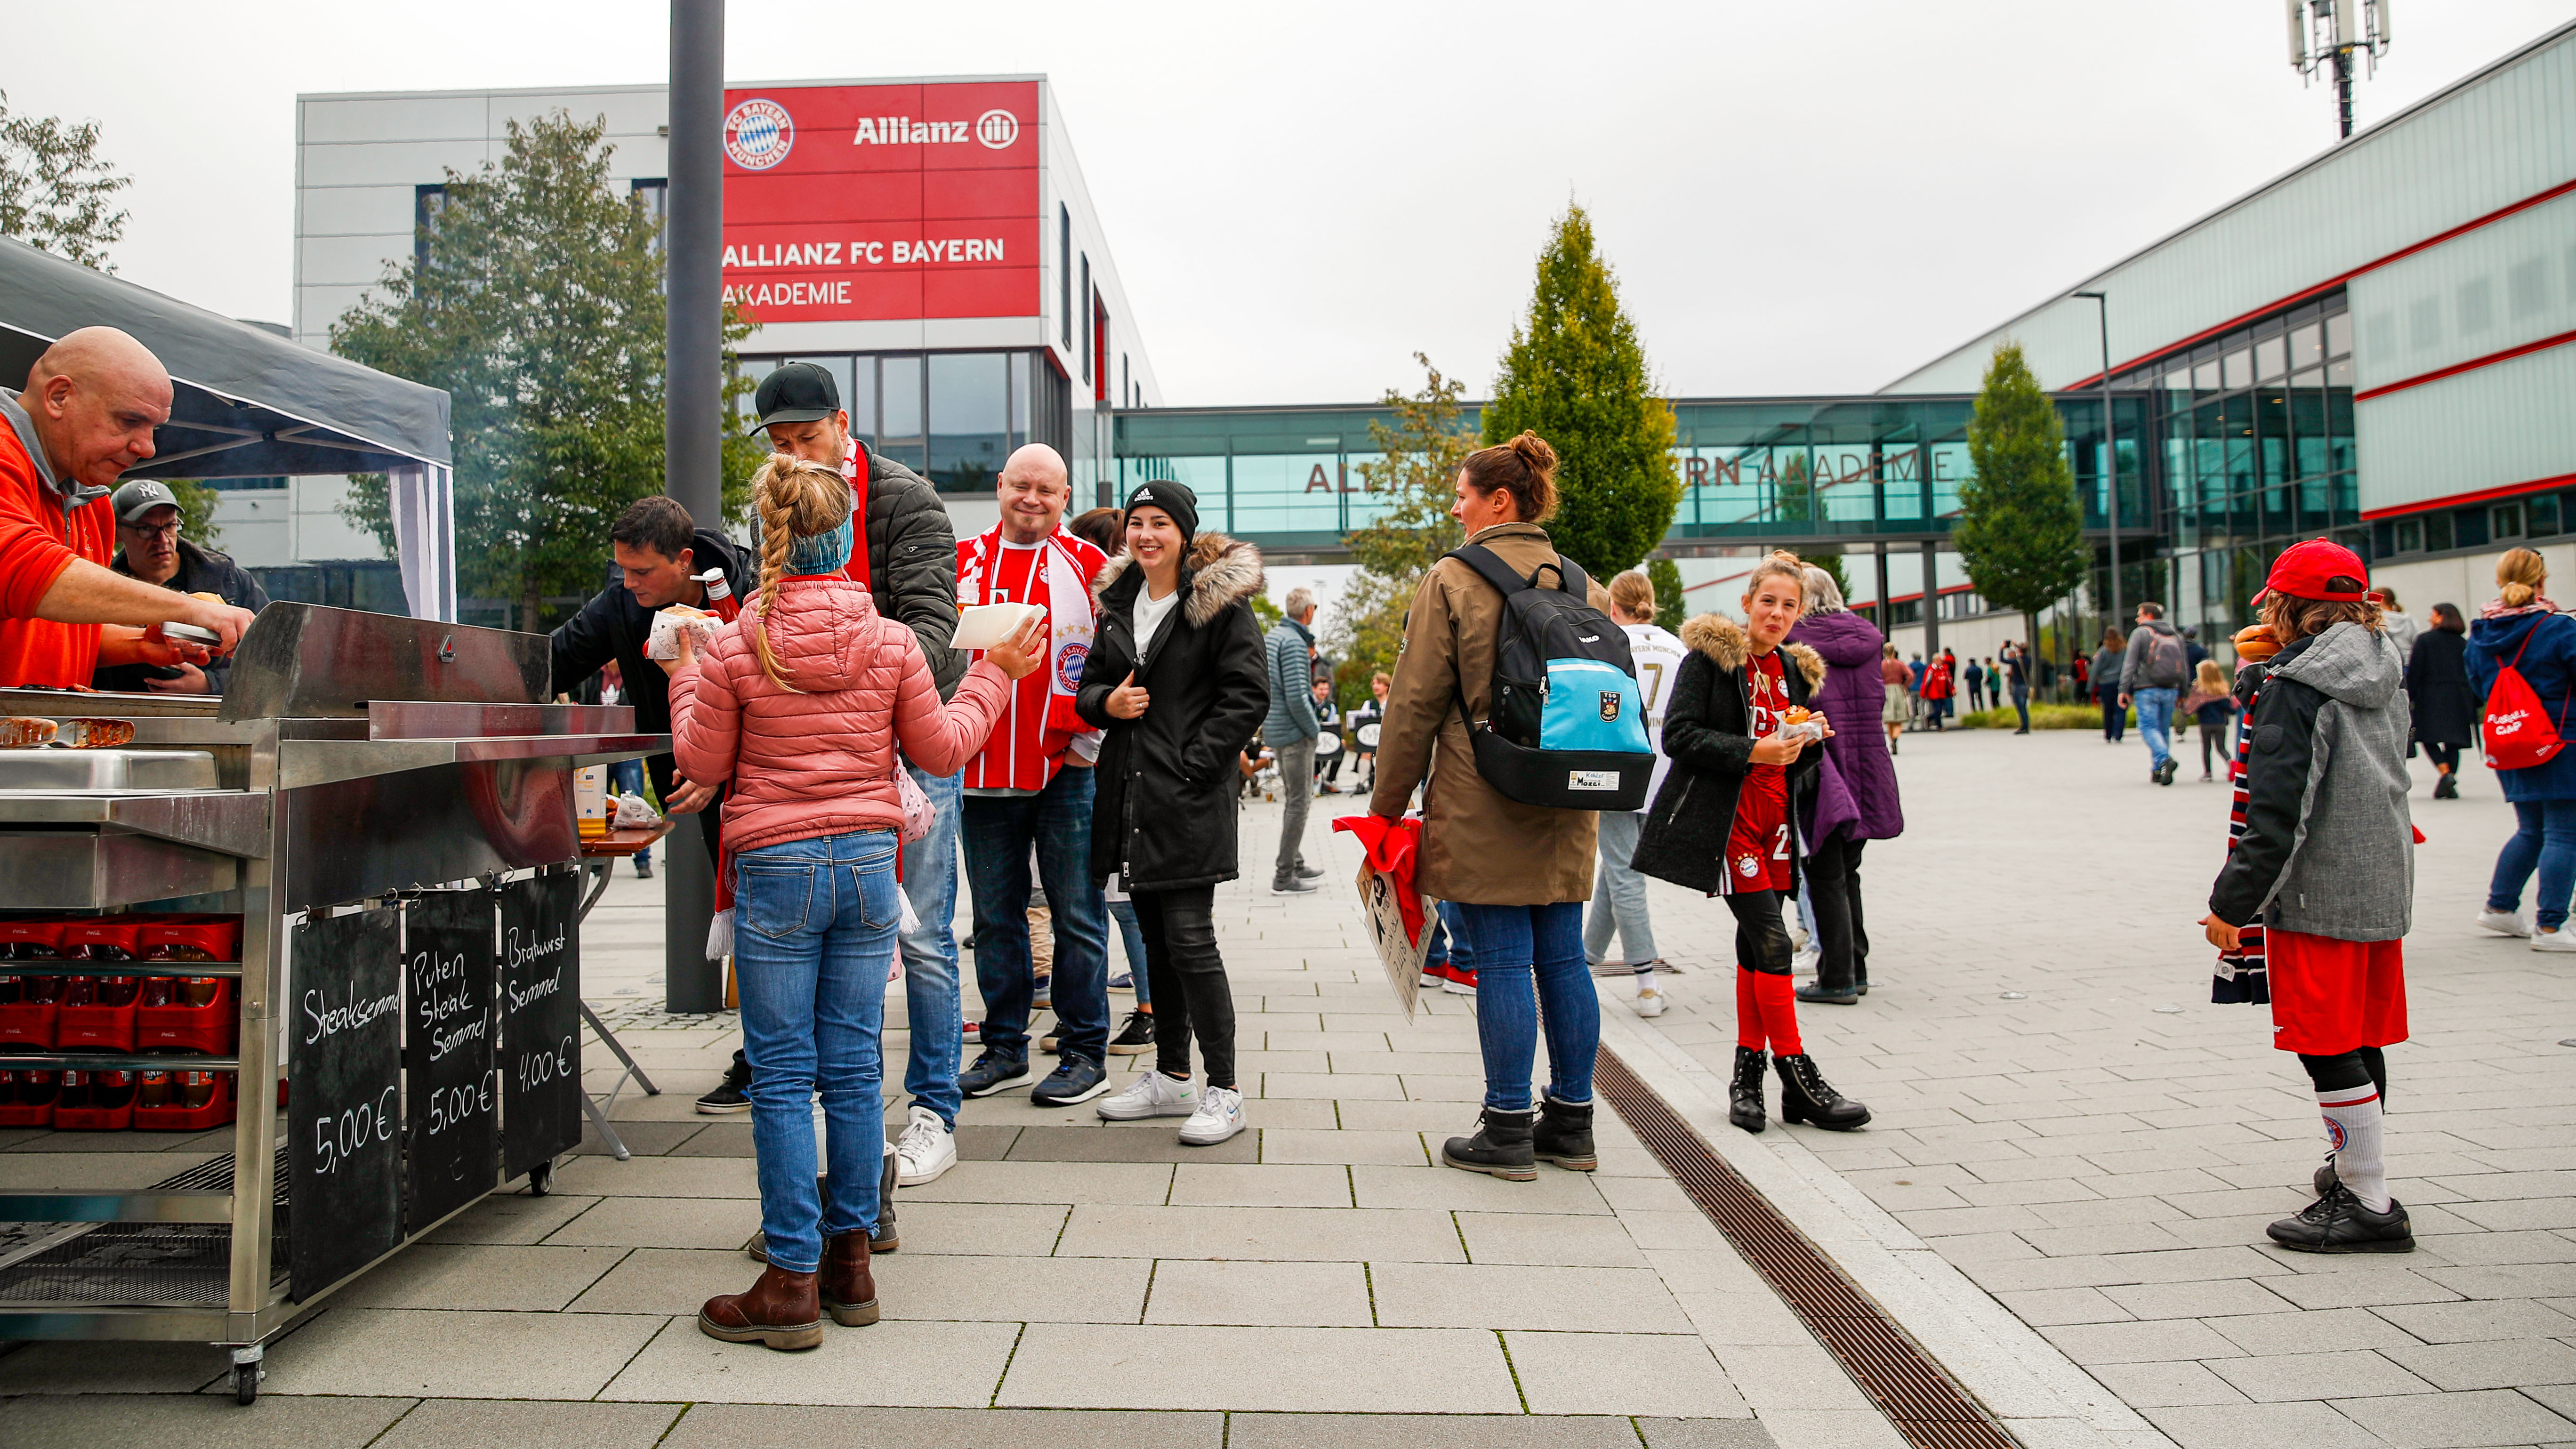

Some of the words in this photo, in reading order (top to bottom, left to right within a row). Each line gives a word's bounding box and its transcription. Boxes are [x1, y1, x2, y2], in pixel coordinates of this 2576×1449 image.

[728, 113, 742, 131] FC
[741, 103, 789, 129] BAYERN
[853, 116, 969, 145] Allianz
[722, 242, 842, 267] ALLIANZ
[850, 242, 884, 265] FC
[892, 239, 1004, 264] BAYERN
[722, 281, 852, 306] AKADEMIE
[1067, 647, 1089, 659] BAYER
[1643, 663, 1663, 711] 7
[509, 923, 565, 968] Bratwurst
[414, 951, 464, 996] Puten
[509, 967, 561, 1014] Semmel
[430, 1007, 488, 1062] Semmel
